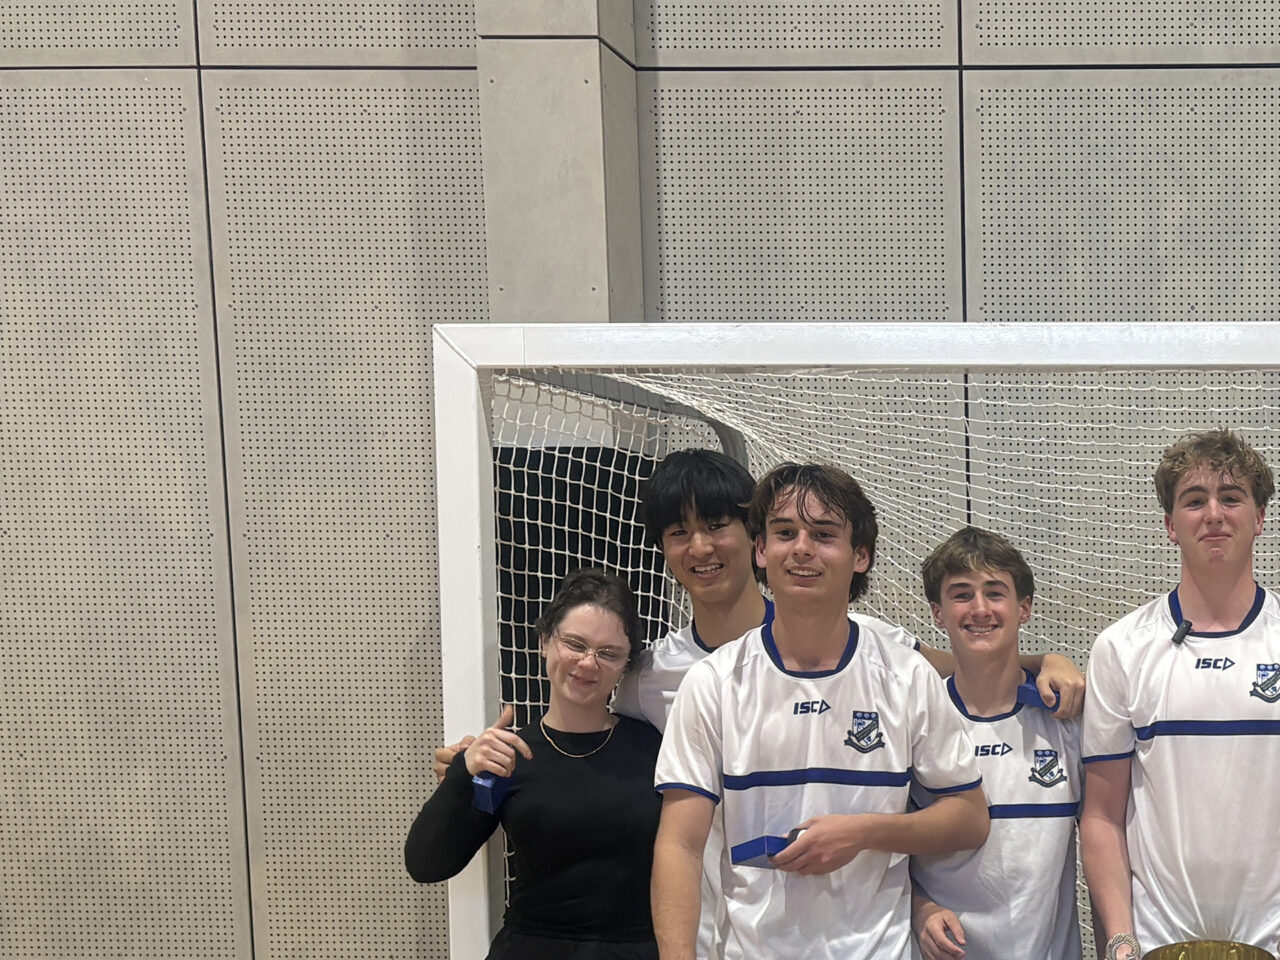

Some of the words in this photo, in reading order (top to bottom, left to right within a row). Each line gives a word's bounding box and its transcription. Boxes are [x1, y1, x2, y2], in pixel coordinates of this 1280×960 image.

[1194, 657, 1223, 670] ISC
[793, 700, 820, 715] ISC
[974, 744, 1002, 757] ISC
